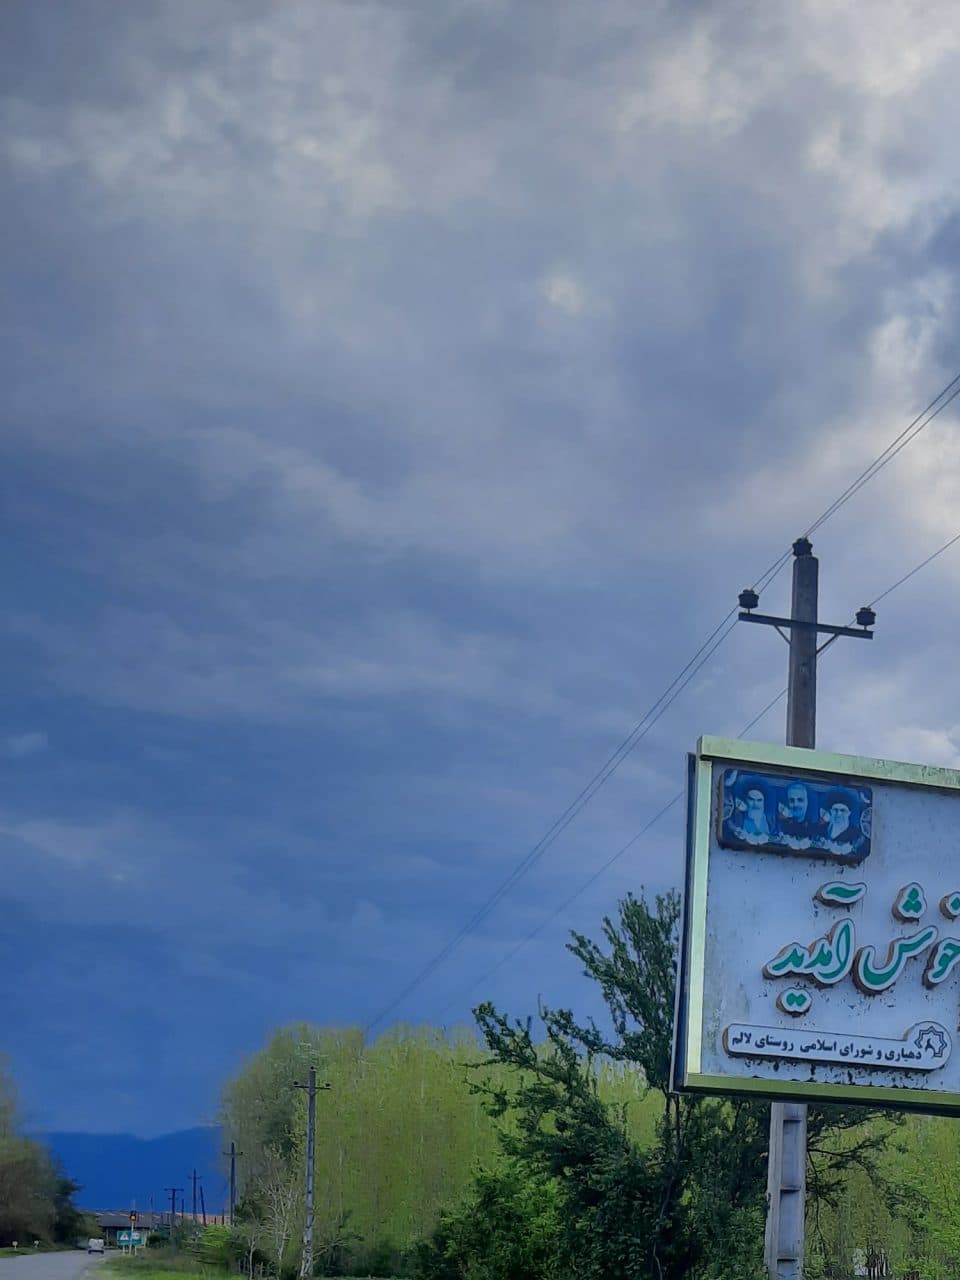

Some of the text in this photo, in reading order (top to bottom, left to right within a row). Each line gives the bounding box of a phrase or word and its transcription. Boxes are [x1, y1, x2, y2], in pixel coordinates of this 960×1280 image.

[768, 882, 867, 1013] آمدید
[731, 1032, 922, 1062] دهیاری و شورای اسلامی روستای لالم
